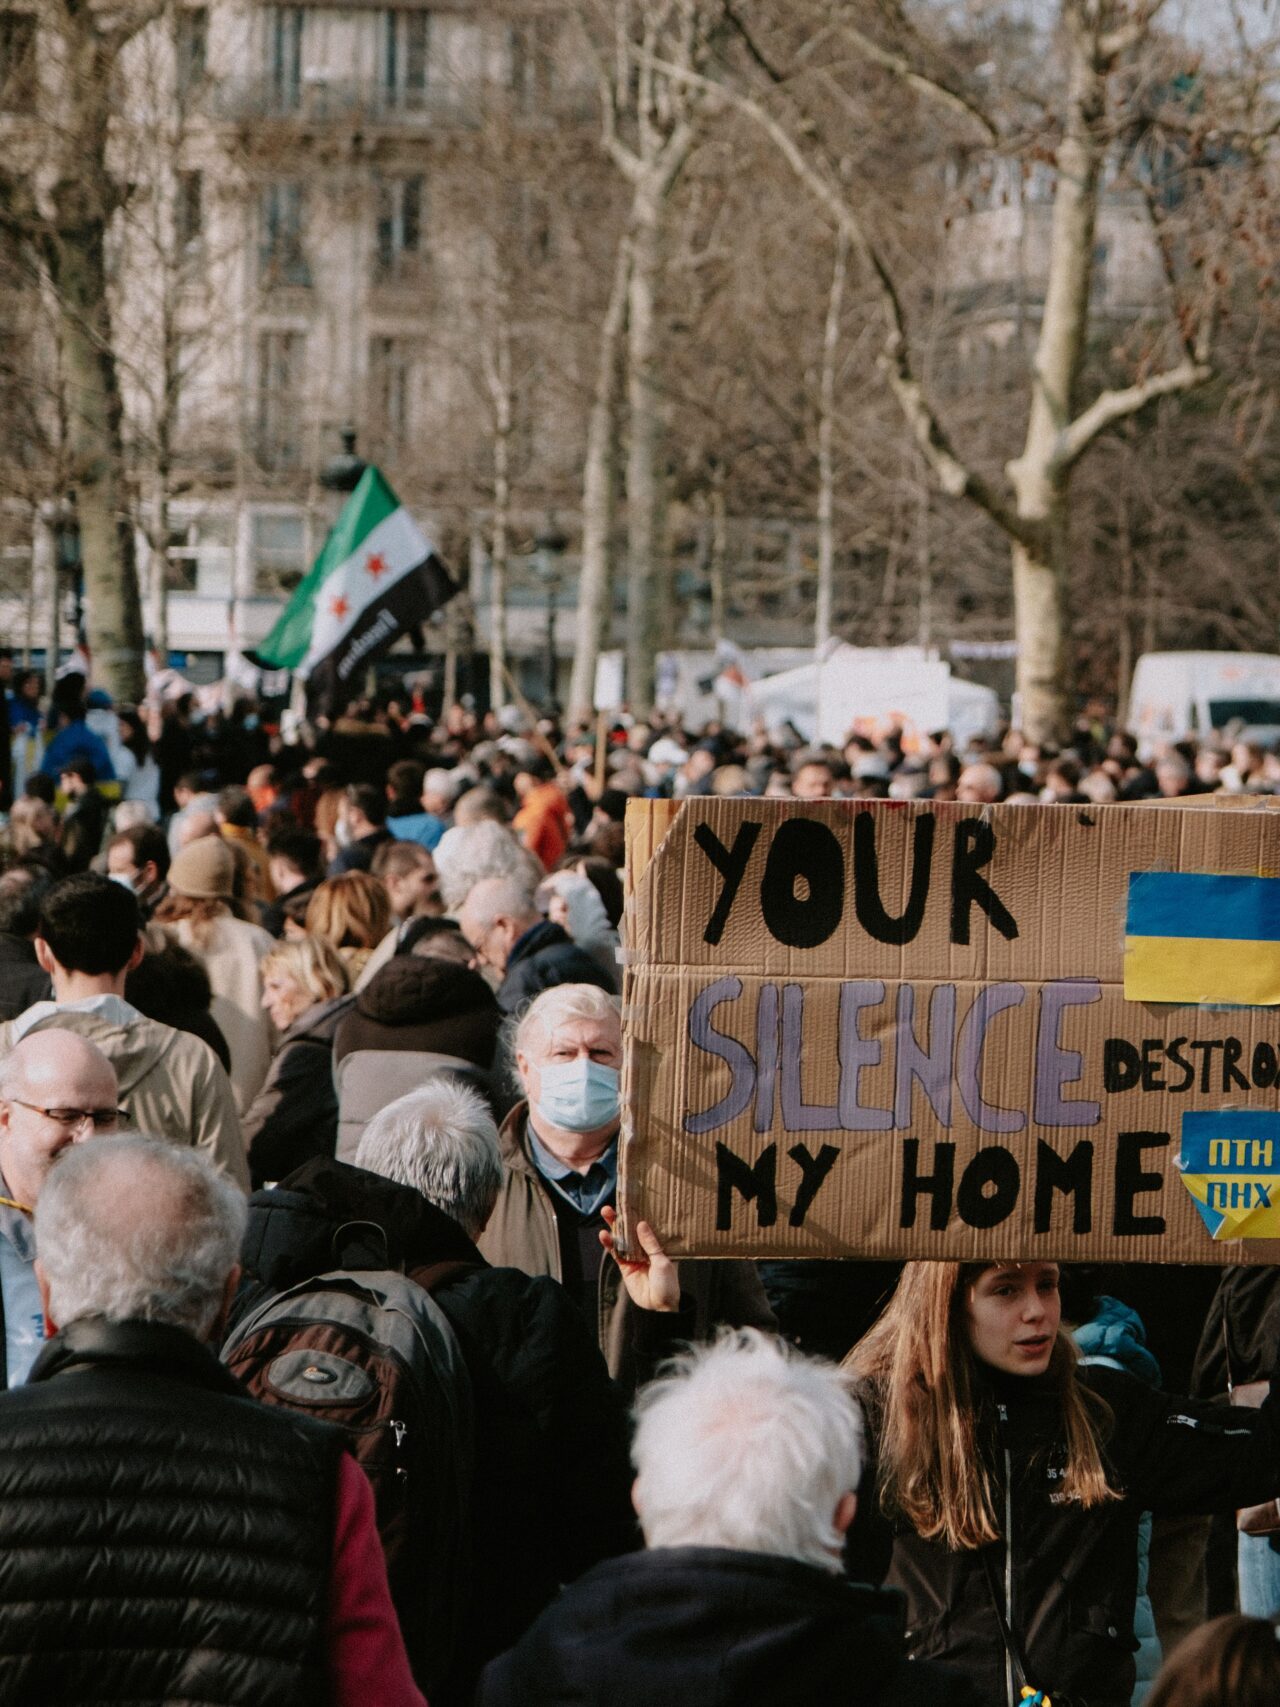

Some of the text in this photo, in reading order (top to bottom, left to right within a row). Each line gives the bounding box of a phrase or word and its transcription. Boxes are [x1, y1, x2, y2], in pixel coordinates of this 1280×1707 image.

[694, 813, 1020, 949] YOUR
[683, 974, 1102, 1134] SILENCE
[715, 1131, 1171, 1237] MY HOME
[1206, 1182, 1273, 1209] ПНХ
[1208, 1138, 1273, 1167] ПТН
